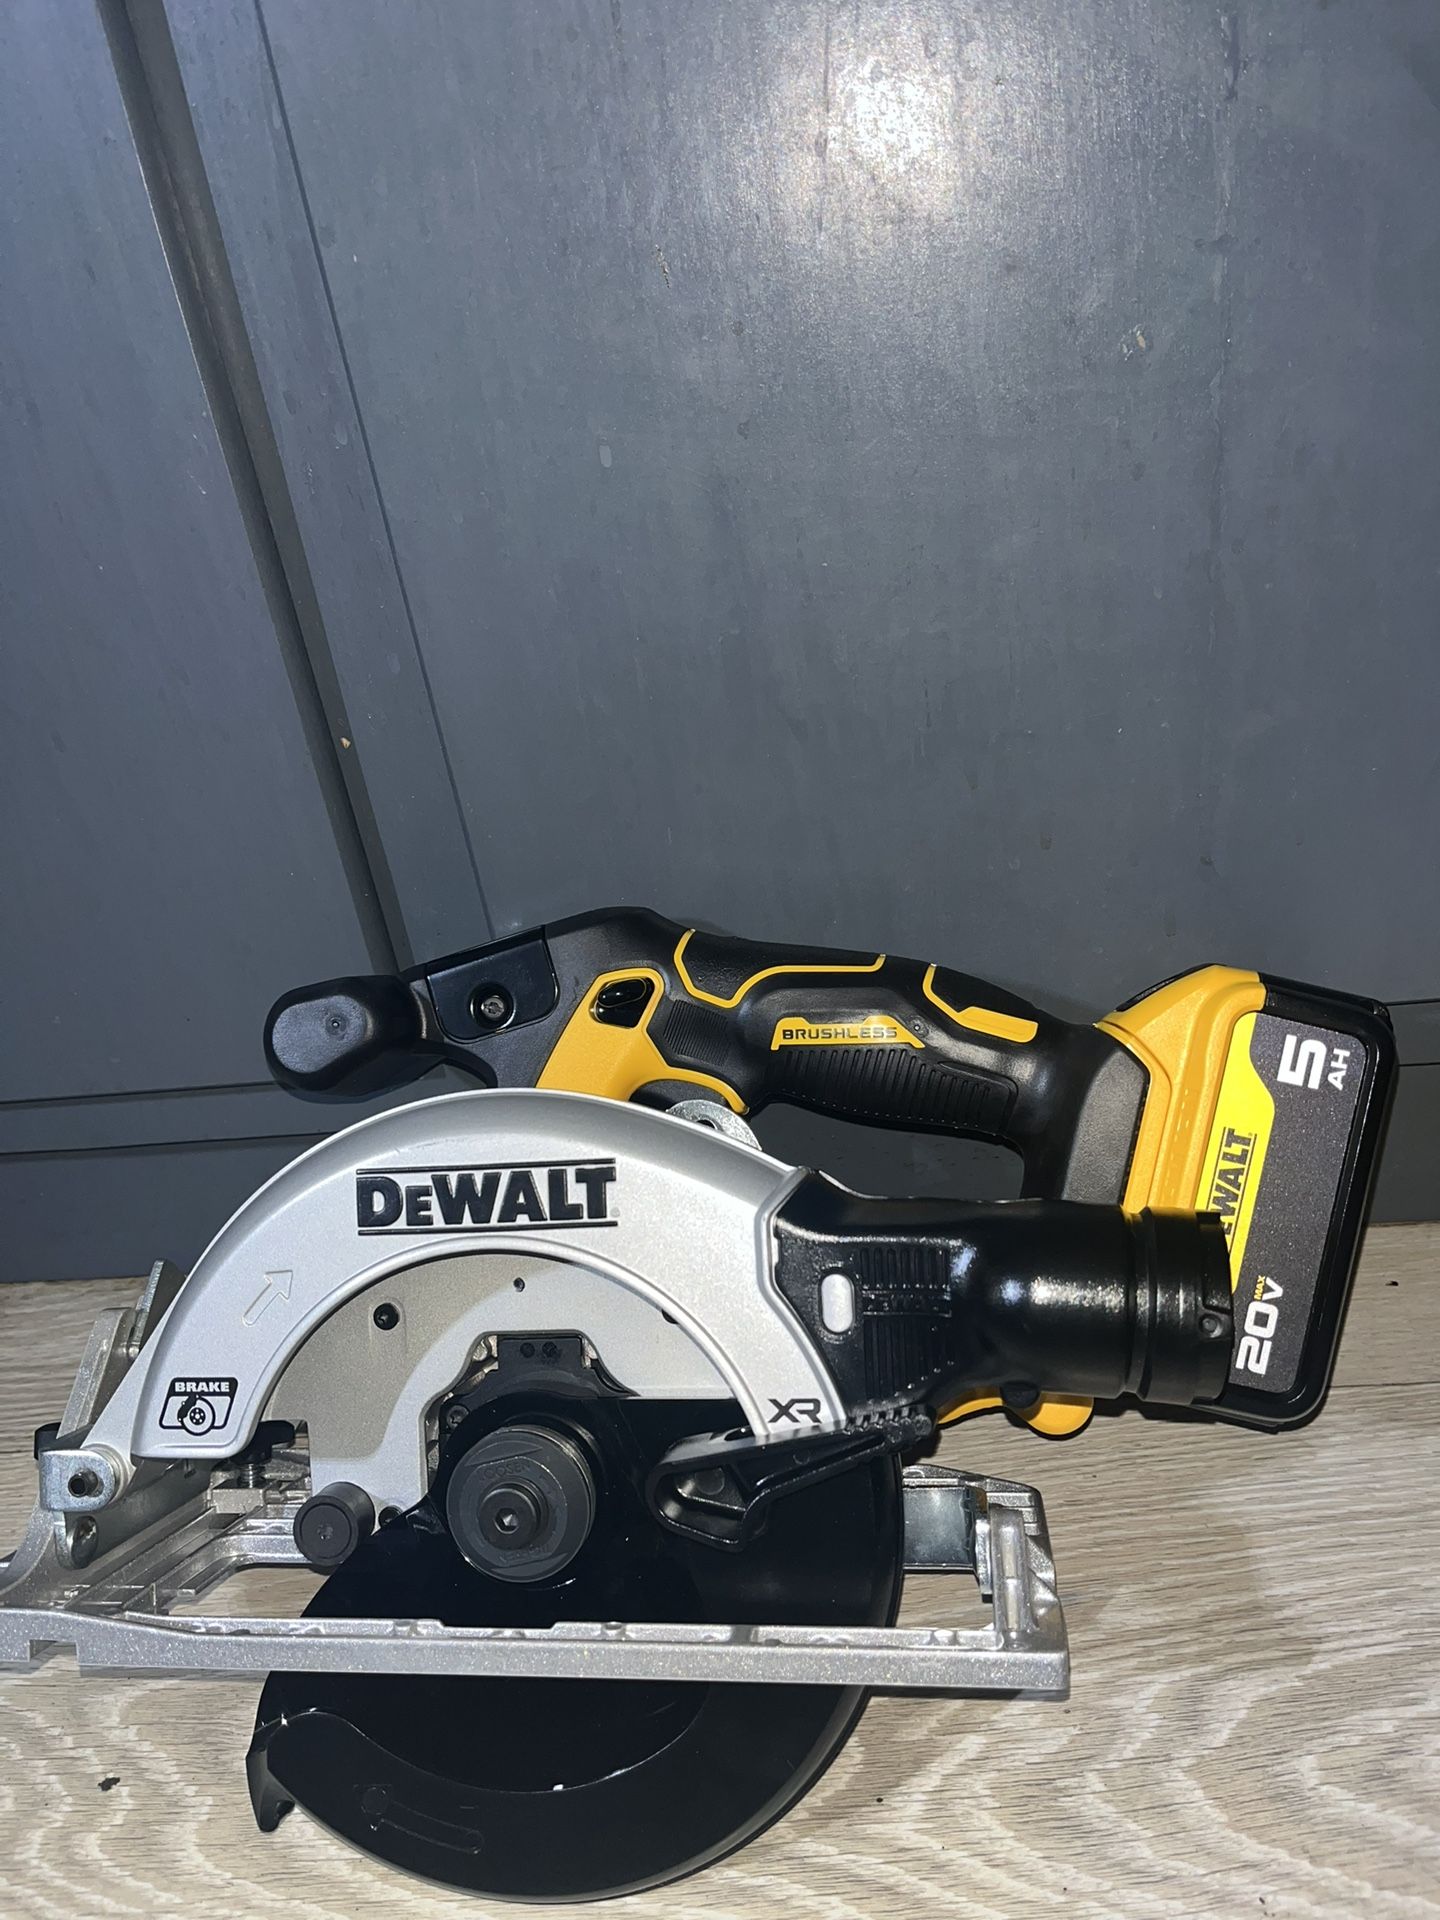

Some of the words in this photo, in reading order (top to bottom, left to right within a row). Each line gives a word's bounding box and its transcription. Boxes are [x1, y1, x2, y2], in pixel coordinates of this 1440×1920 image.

[782, 1027, 898, 1040] BRUSHLESS
[1276, 1034, 1327, 1090] 5
[1327, 1047, 1351, 1091] AH
[1211, 1127, 1252, 1236] EWALT
[1253, 1274, 1266, 1301] MAX
[1235, 1276, 1283, 1375] 20V
[174, 1381, 230, 1393] BRAKE
[767, 1398, 822, 1424] XR
